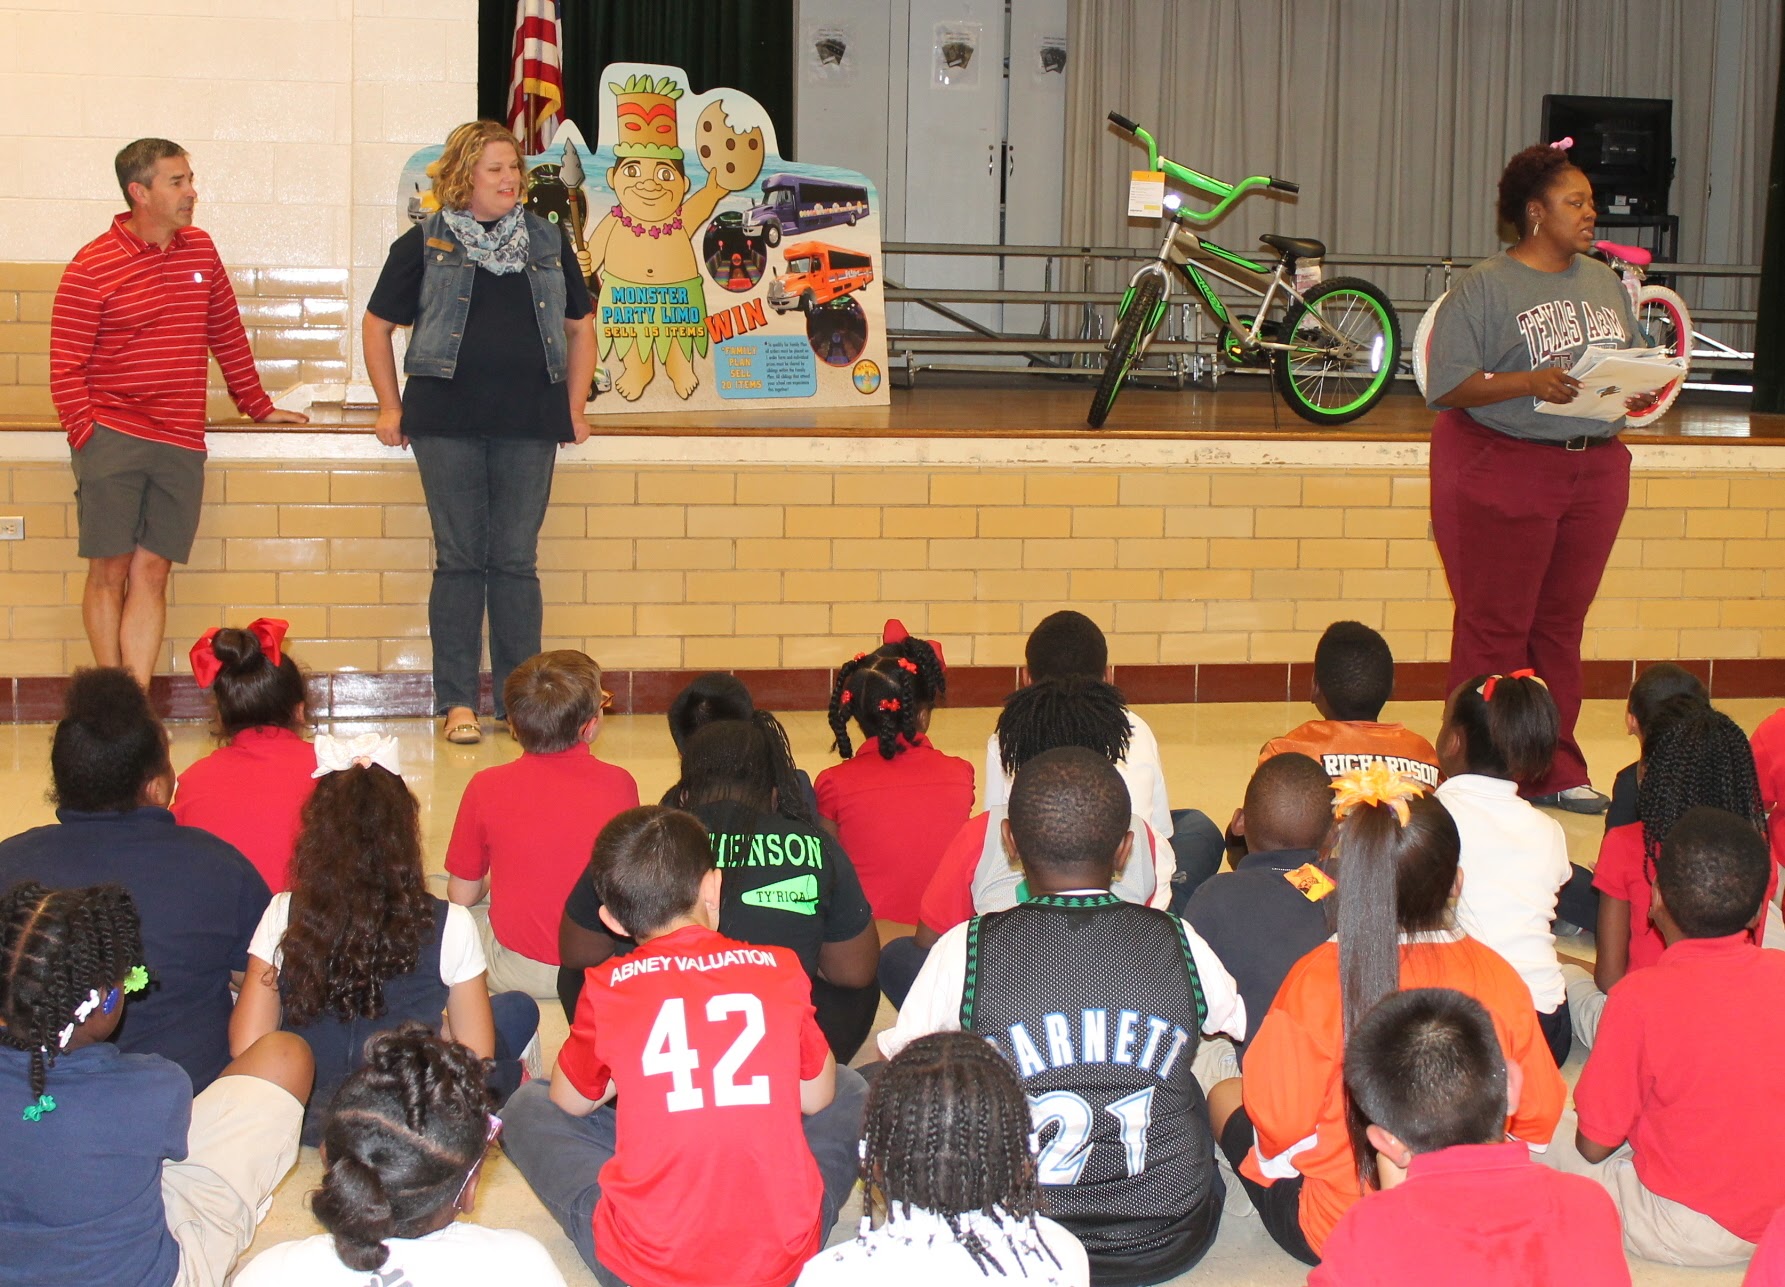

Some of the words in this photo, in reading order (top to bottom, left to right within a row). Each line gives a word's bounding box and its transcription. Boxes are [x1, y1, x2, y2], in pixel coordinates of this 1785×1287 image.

[611, 286, 689, 304] MONSTER
[602, 306, 655, 324] PARTY
[661, 306, 700, 324] LIMO
[703, 297, 768, 344] WIN
[604, 326, 637, 337] SELL
[644, 326, 660, 337] 15
[665, 326, 705, 337] ITEMS
[1516, 300, 1583, 371] TEXAS
[1581, 300, 1626, 342] A&M
[728, 358, 752, 367] PLAN
[730, 369, 752, 378] SELL
[721, 380, 732, 390] 20
[735, 380, 762, 390] ITEMS
[756, 890, 806, 904] TY'RIQA
[610, 956, 671, 987] ABNEY
[674, 949, 777, 971] VALUATION
[984, 1007, 1188, 1080] ARNETT
[641, 993, 771, 1113] 42
[1025, 1085, 1156, 1186] 21
